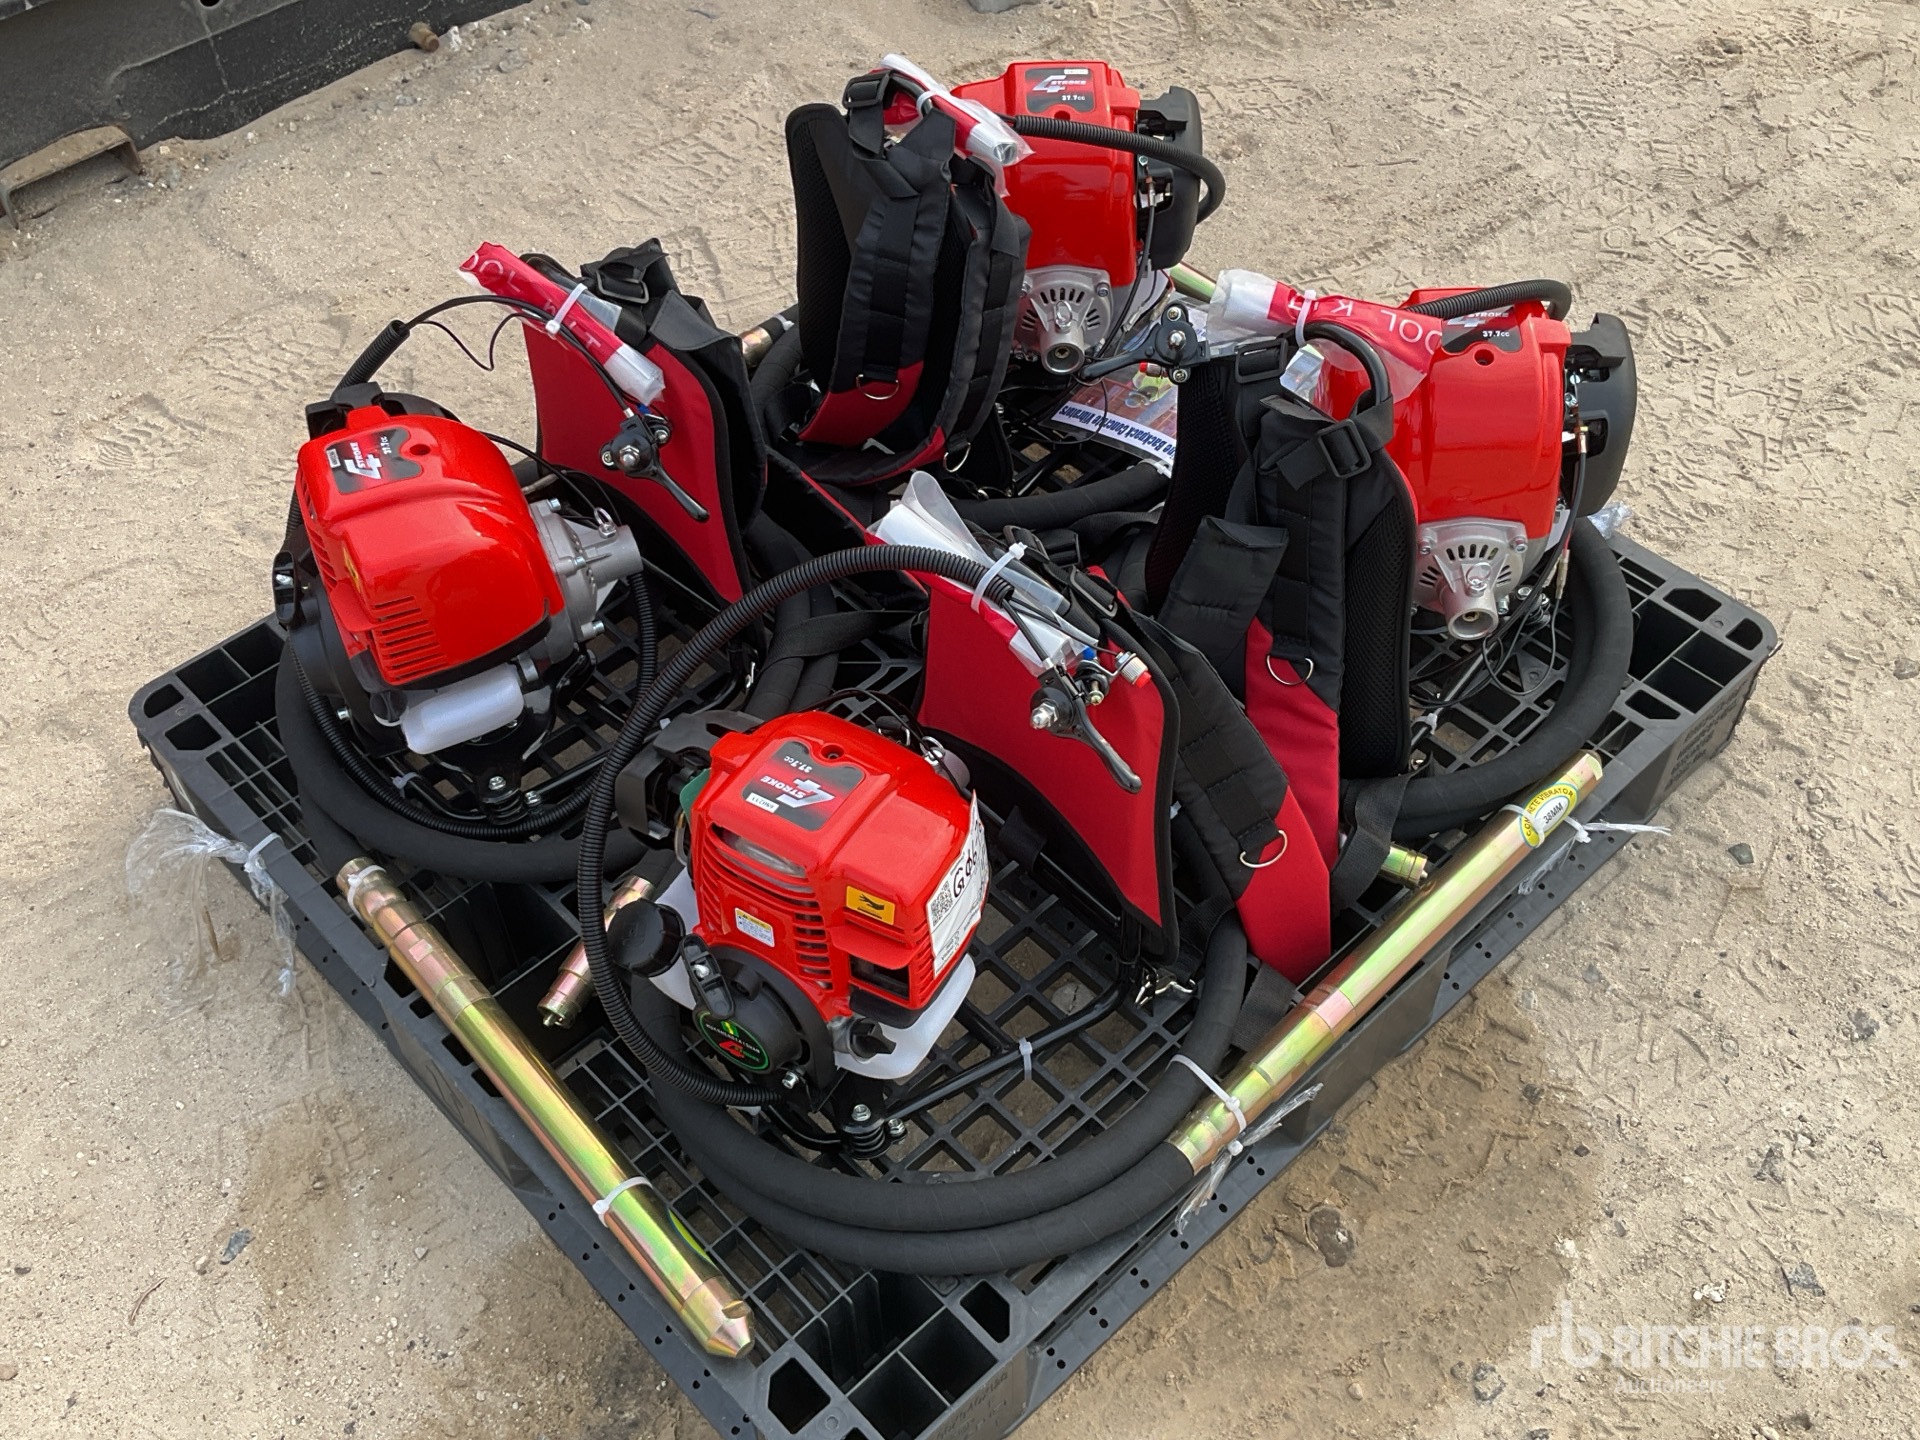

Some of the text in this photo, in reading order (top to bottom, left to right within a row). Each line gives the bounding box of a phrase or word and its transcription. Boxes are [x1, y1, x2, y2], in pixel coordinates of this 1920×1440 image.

[1032, 75, 1066, 93] 4
[1481, 329, 1511, 338] 37.7cc
[1058, 405, 1095, 425] Vibrators
[1125, 426, 1166, 452] Backpack
[344, 442, 382, 479] 4 STROKE
[783, 755, 812, 773] 37.7cc
[760, 775, 835, 808] 4 STROKE
[1540, 787, 1574, 801] VIBRATOR
[1543, 802, 1564, 824] 38MM
